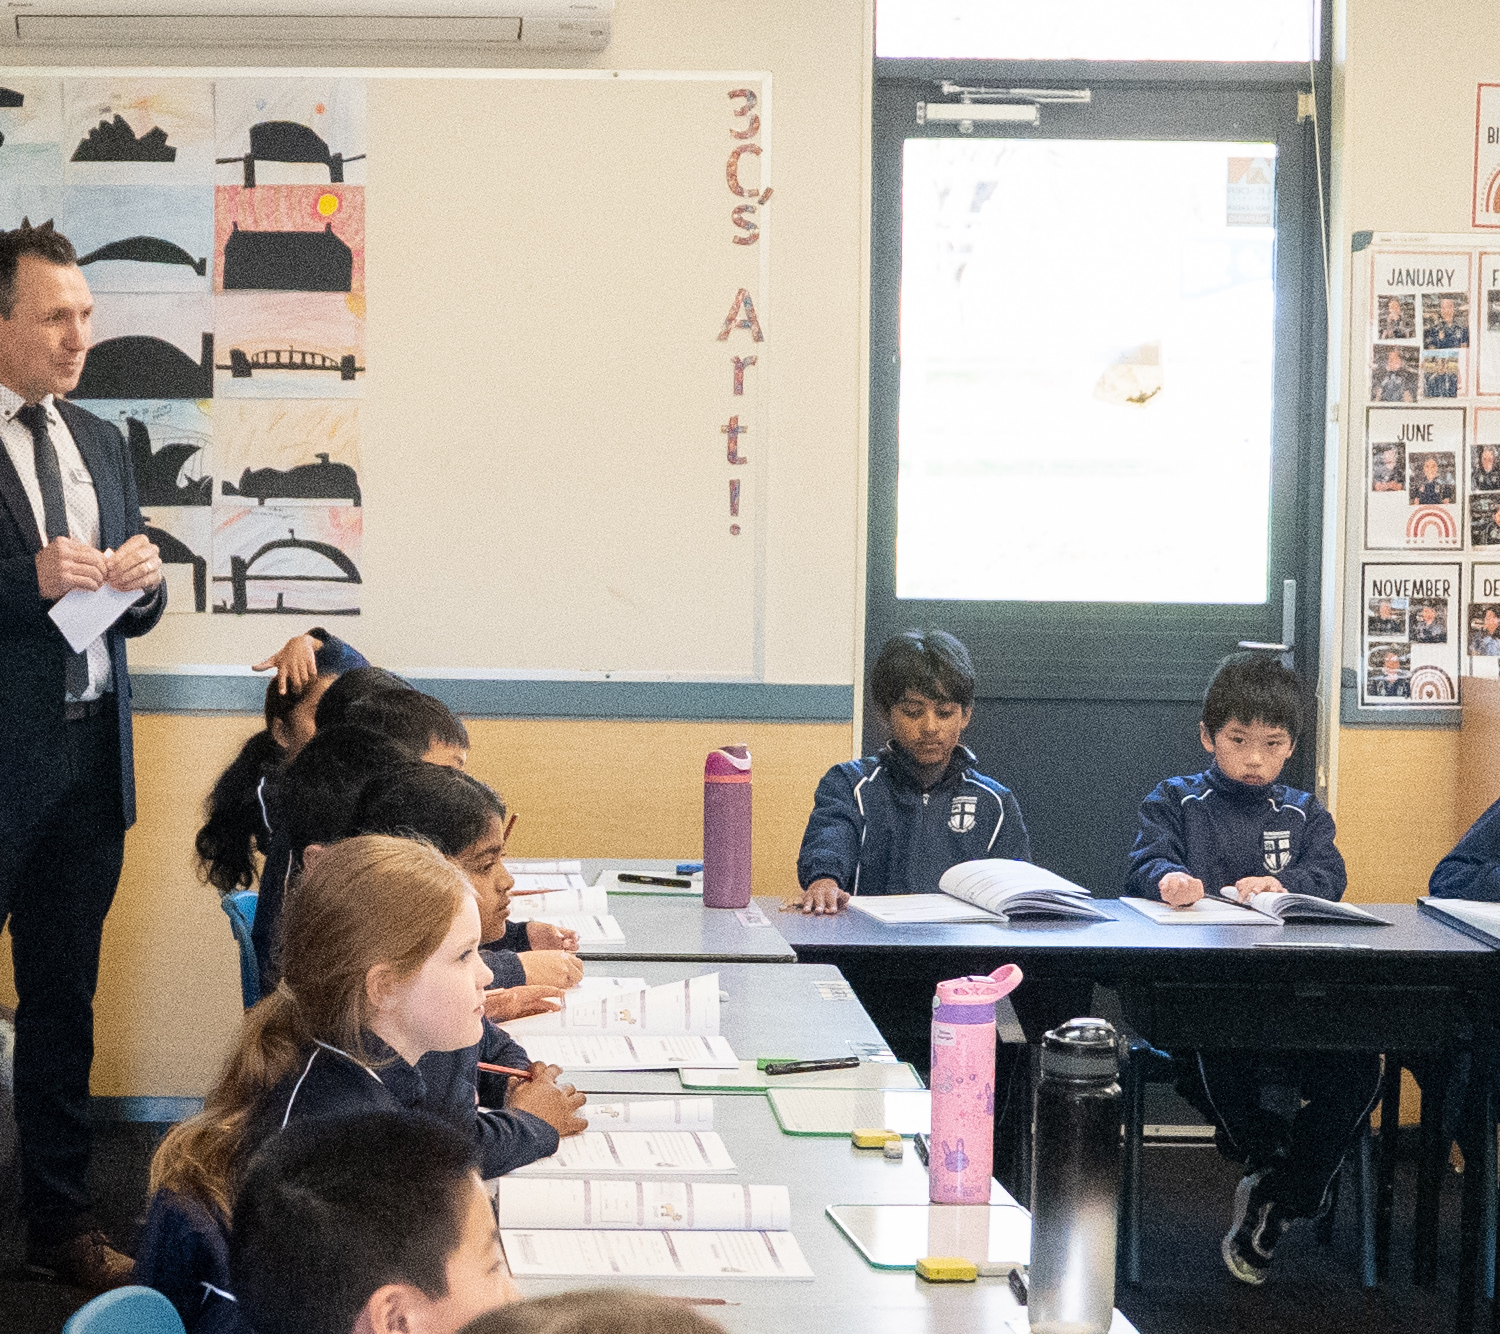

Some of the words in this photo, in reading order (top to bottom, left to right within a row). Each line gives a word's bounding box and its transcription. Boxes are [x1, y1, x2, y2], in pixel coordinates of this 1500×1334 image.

[1386, 268, 1455, 287] JANUARY
[1397, 423, 1434, 442] JUNE
[1372, 579, 1451, 597] NOVEMBER
